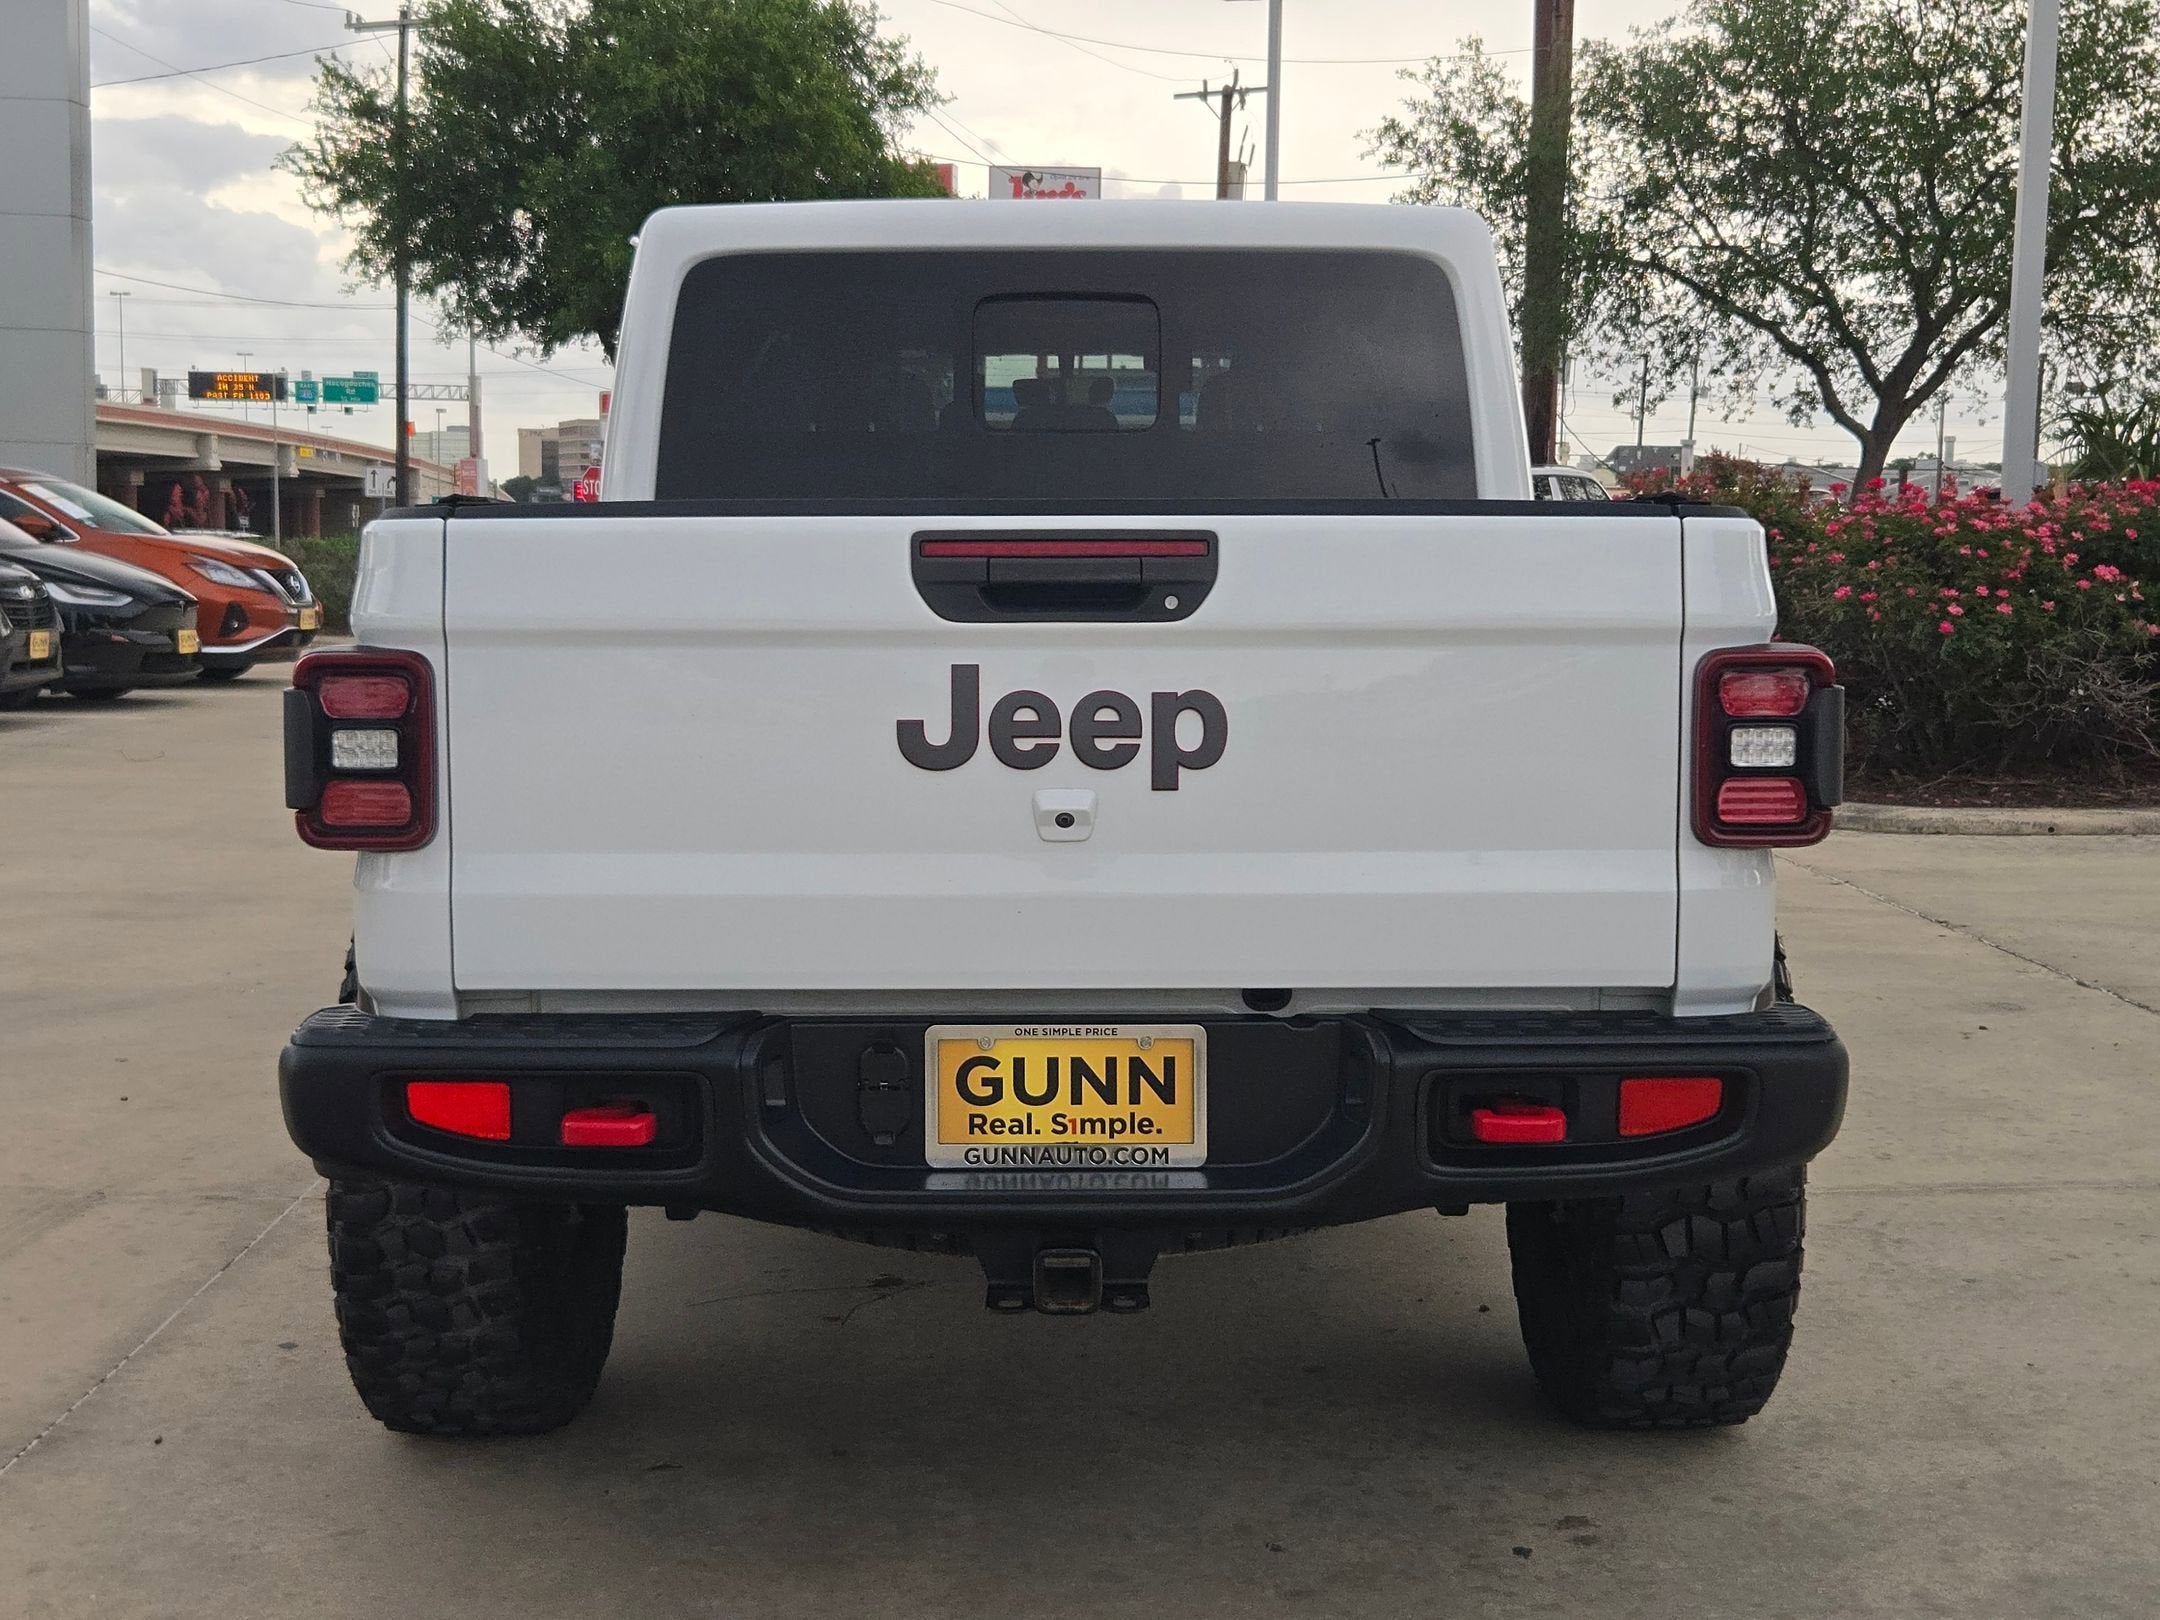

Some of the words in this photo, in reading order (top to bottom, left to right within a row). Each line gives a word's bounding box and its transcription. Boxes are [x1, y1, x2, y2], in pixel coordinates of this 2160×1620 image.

[216, 374, 259, 382] ACCIDENT
[233, 383, 244, 391] 35
[248, 383, 255, 391] N
[206, 391, 228, 399] PAST
[250, 391, 271, 400] 1103
[583, 480, 600, 495] STO
[896, 664, 1228, 791] Jeep
[1014, 1027, 1039, 1036] ONE
[1042, 1027, 1082, 1036] SIMPLE
[1085, 1027, 1119, 1036] PRICE
[955, 1055, 1176, 1107] GUNN
[968, 1112, 1041, 1136] Real.
[963, 1147, 1170, 1166] GUNNAUTO.COM
